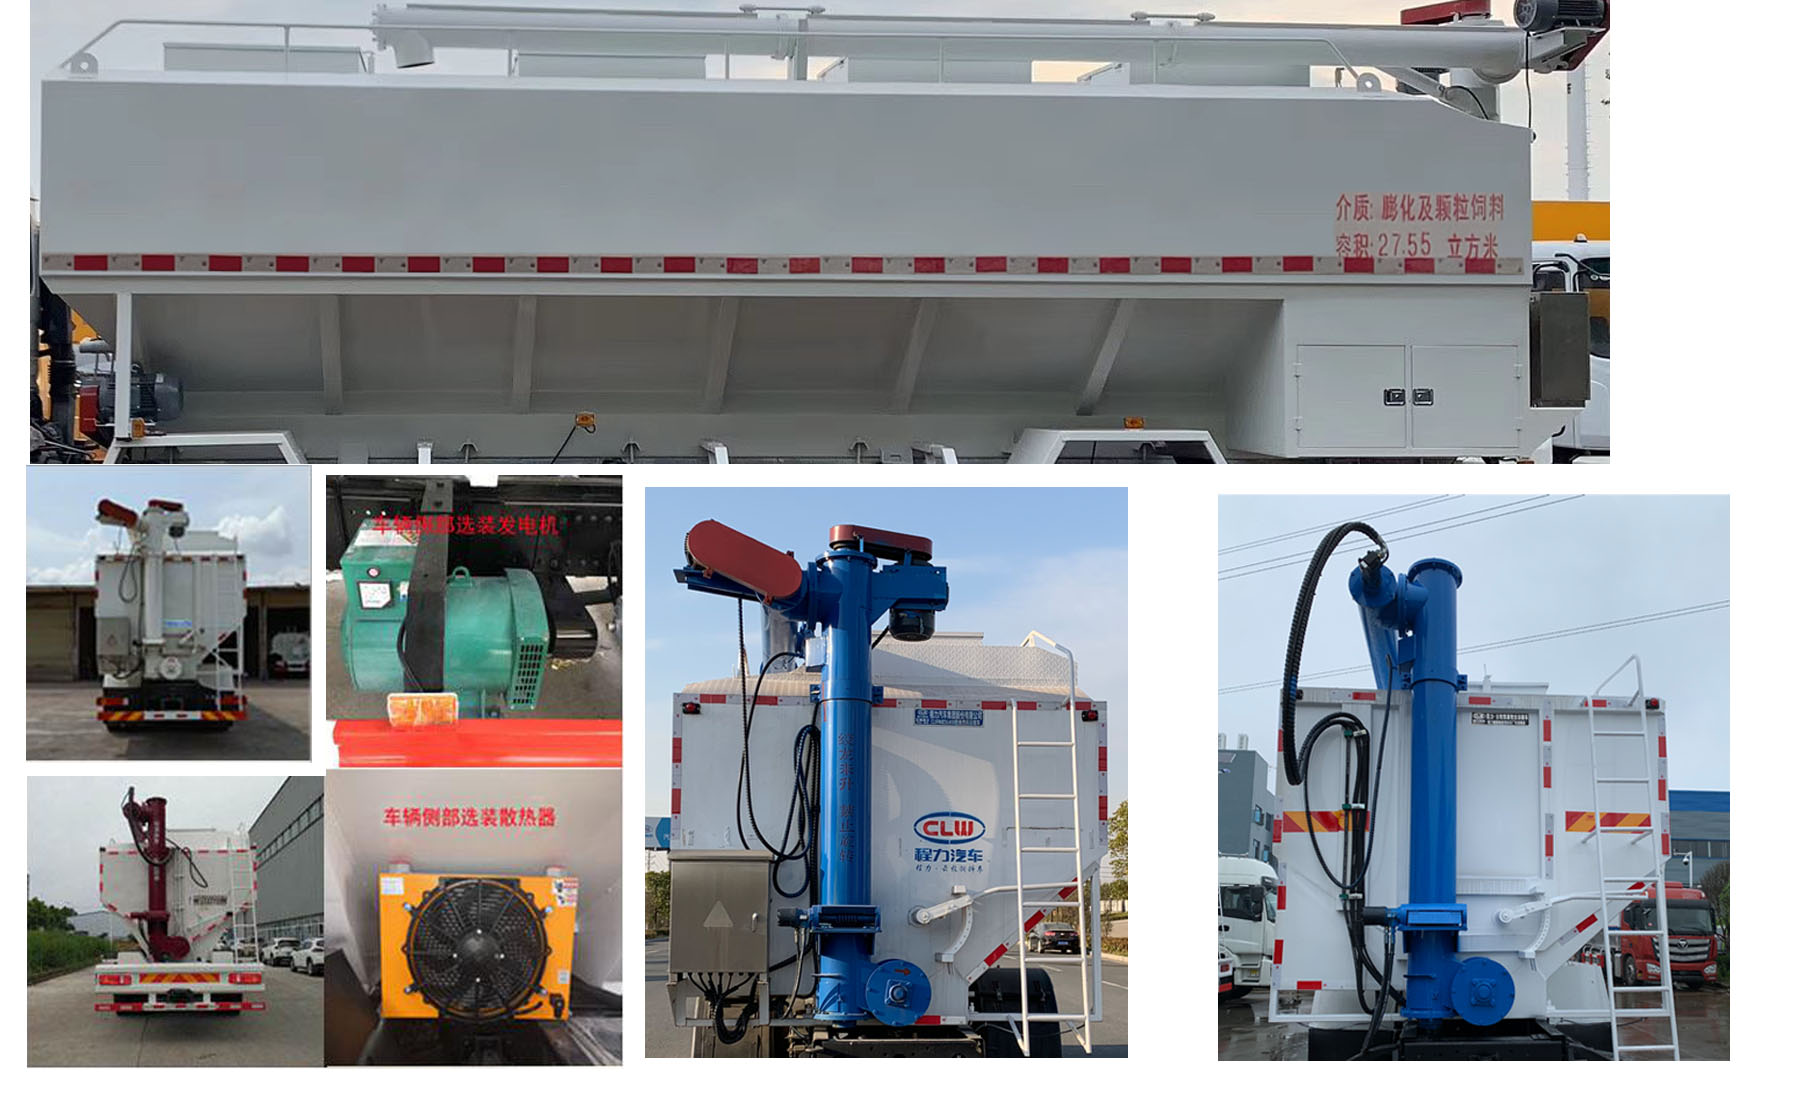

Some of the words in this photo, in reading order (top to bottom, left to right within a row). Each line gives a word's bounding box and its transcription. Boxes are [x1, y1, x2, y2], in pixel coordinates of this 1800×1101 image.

[922, 820, 974, 836] CLW
[914, 847, 983, 863] 程力汽车
